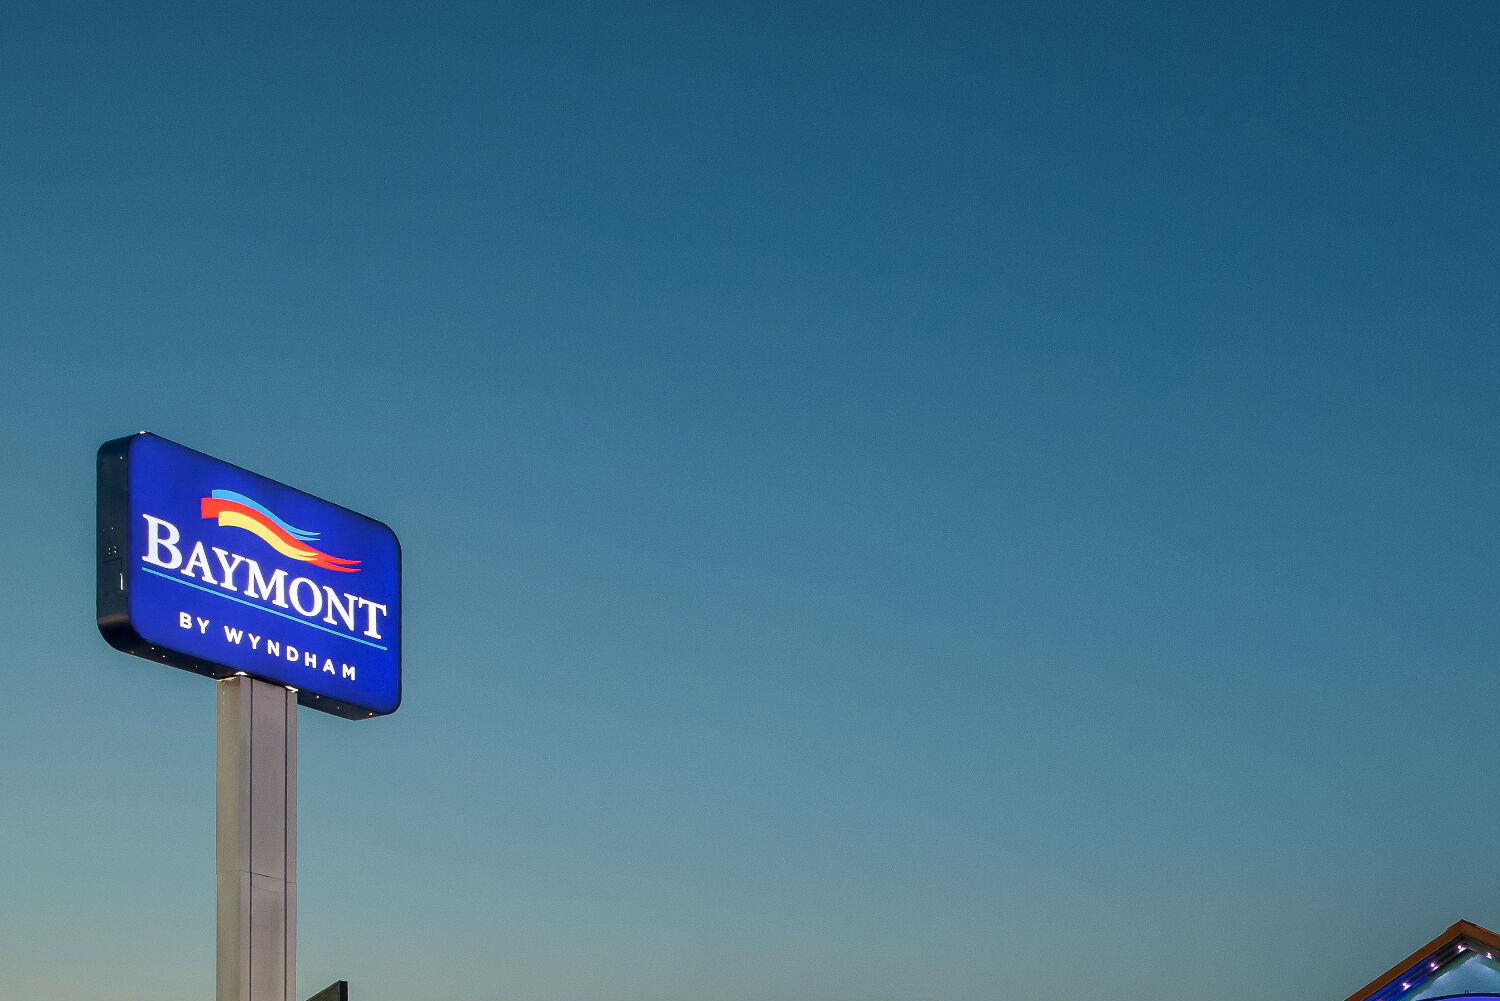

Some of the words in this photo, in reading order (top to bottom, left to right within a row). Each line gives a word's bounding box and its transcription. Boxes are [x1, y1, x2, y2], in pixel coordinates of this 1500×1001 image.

[142, 513, 387, 640] BAYMONT
[179, 611, 210, 634] BY
[224, 625, 356, 681] WYNDHAM
